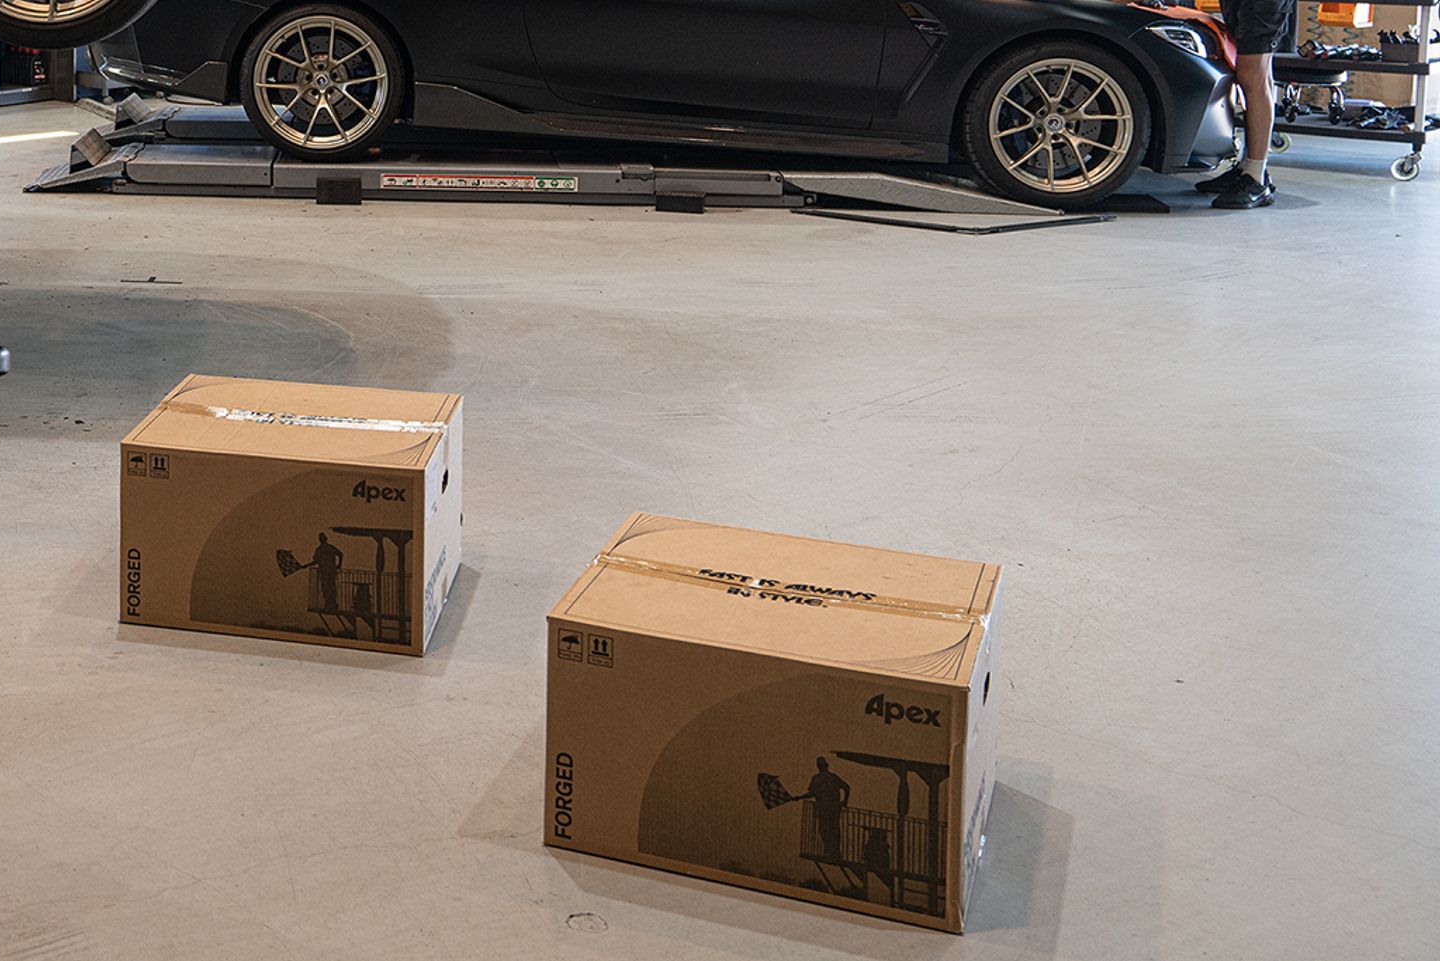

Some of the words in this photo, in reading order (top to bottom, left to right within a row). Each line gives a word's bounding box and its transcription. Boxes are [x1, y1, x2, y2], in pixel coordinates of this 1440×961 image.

[352, 480, 406, 503] Apex
[126, 548, 141, 617] FORGED
[784, 583, 878, 601] ALWAYS
[865, 693, 942, 728] Apex
[554, 751, 574, 840] FORGED
